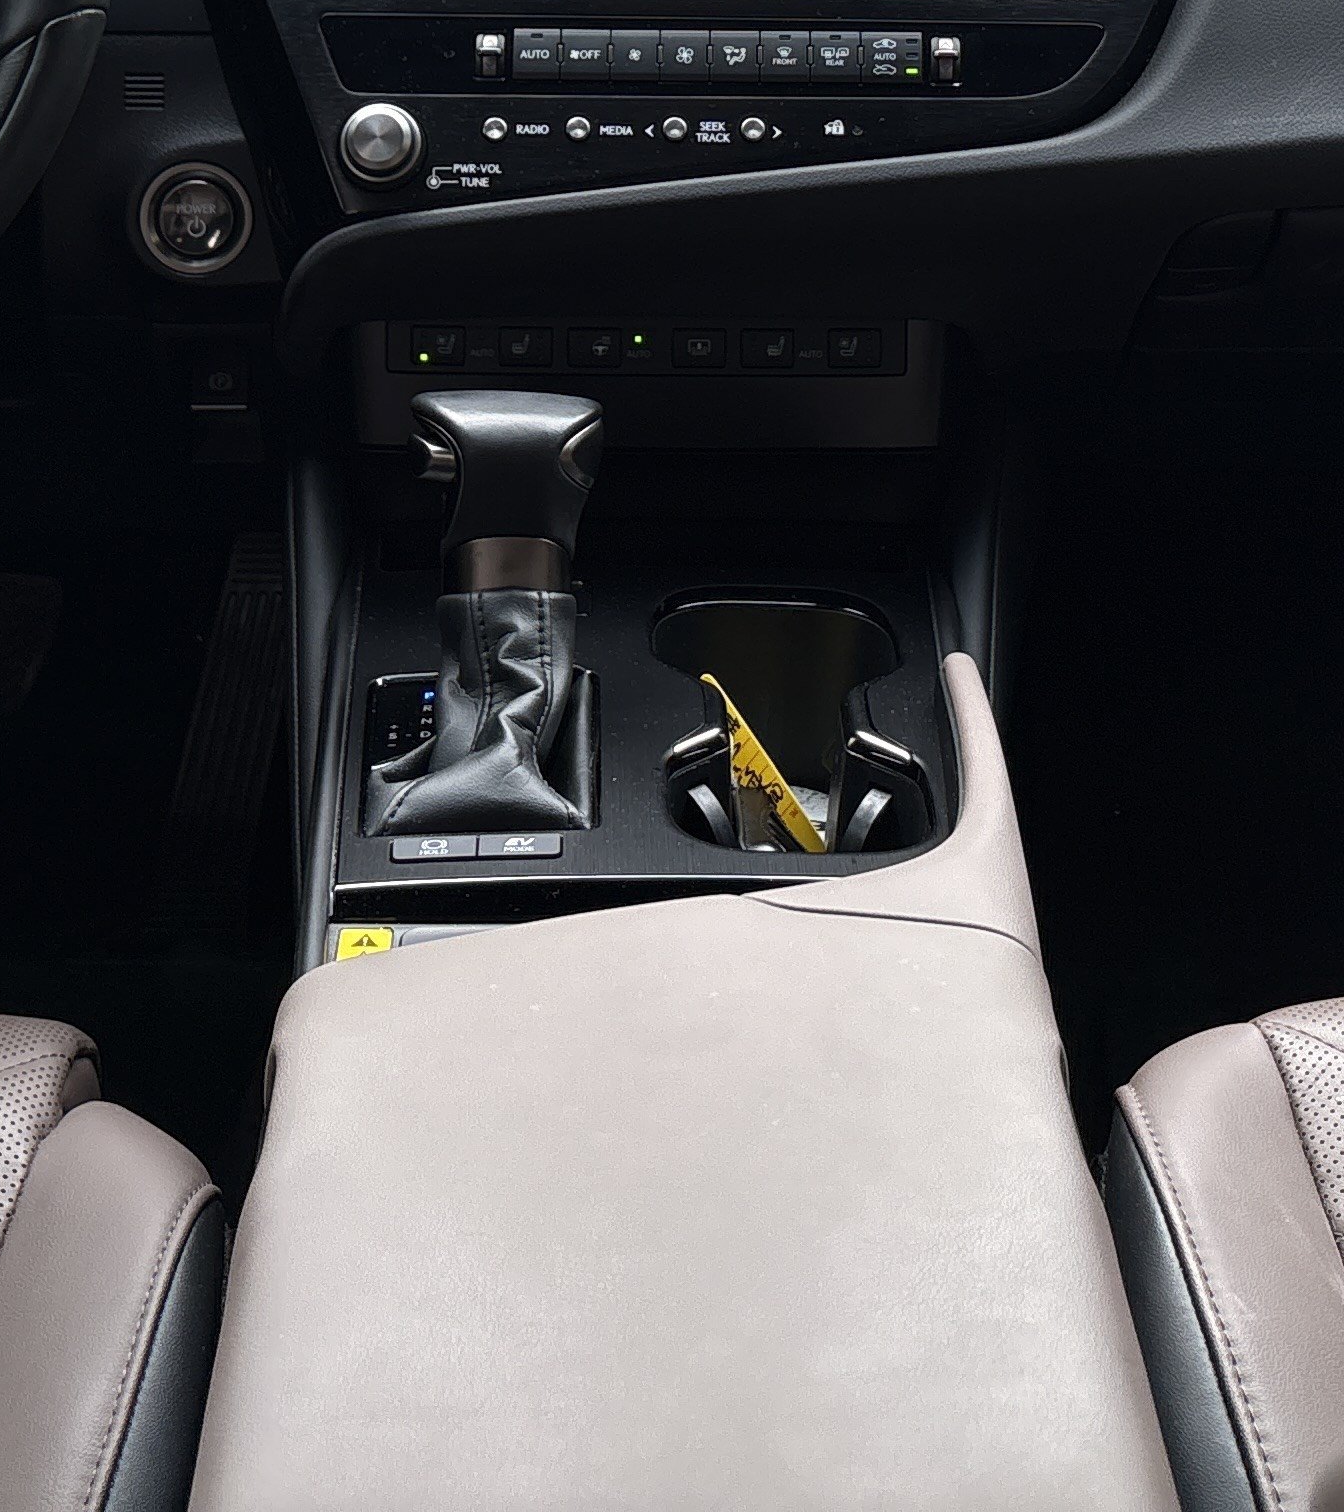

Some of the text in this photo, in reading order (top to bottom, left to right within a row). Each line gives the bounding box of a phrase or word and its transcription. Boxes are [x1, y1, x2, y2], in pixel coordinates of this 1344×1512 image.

[519, 49, 550, 59] AUTO
[581, 49, 601, 59] OFF
[873, 52, 896, 60] AUTO
[772, 57, 798, 65] FRONT
[825, 58, 845, 66] REAR
[515, 123, 550, 134] RADIO
[599, 124, 634, 136] MEDIA
[699, 121, 726, 131] SEEK
[695, 132, 731, 143] TRACK
[460, 176, 490, 187] TUNE
[176, 202, 216, 215] POWER
[470, 348, 495, 357] AUTO
[798, 349, 824, 358] AUTO
